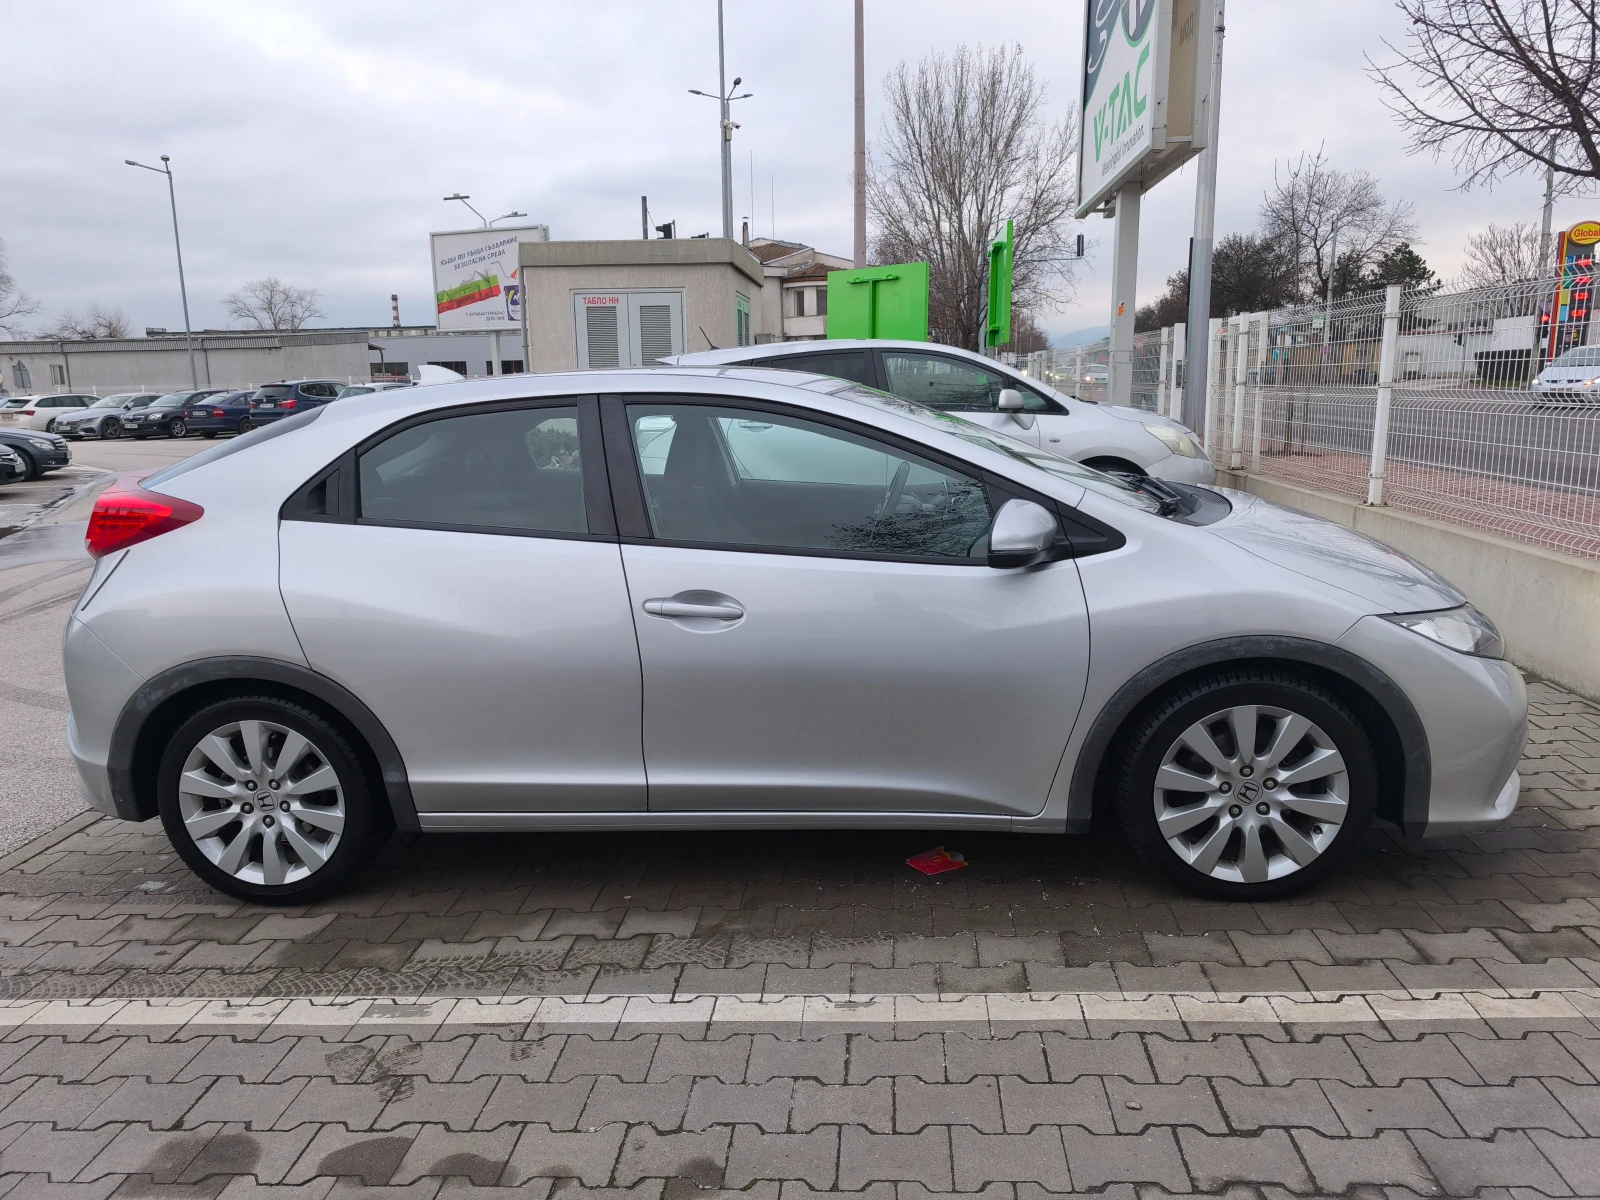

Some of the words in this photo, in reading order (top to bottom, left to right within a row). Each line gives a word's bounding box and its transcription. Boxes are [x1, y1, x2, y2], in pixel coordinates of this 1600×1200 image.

[1093, 40, 1150, 163] V-TAC
[1574, 228, 1600, 237] Global
[441, 256, 456, 266] КЪЩА
[466, 247, 484, 257] КЪЩА
[485, 236, 518, 252] СЪЗДАВАМЕ
[454, 255, 486, 270] БЕЗОПАСНА
[487, 249, 506, 260] СРЕДА
[608, 296, 619, 304] НН
